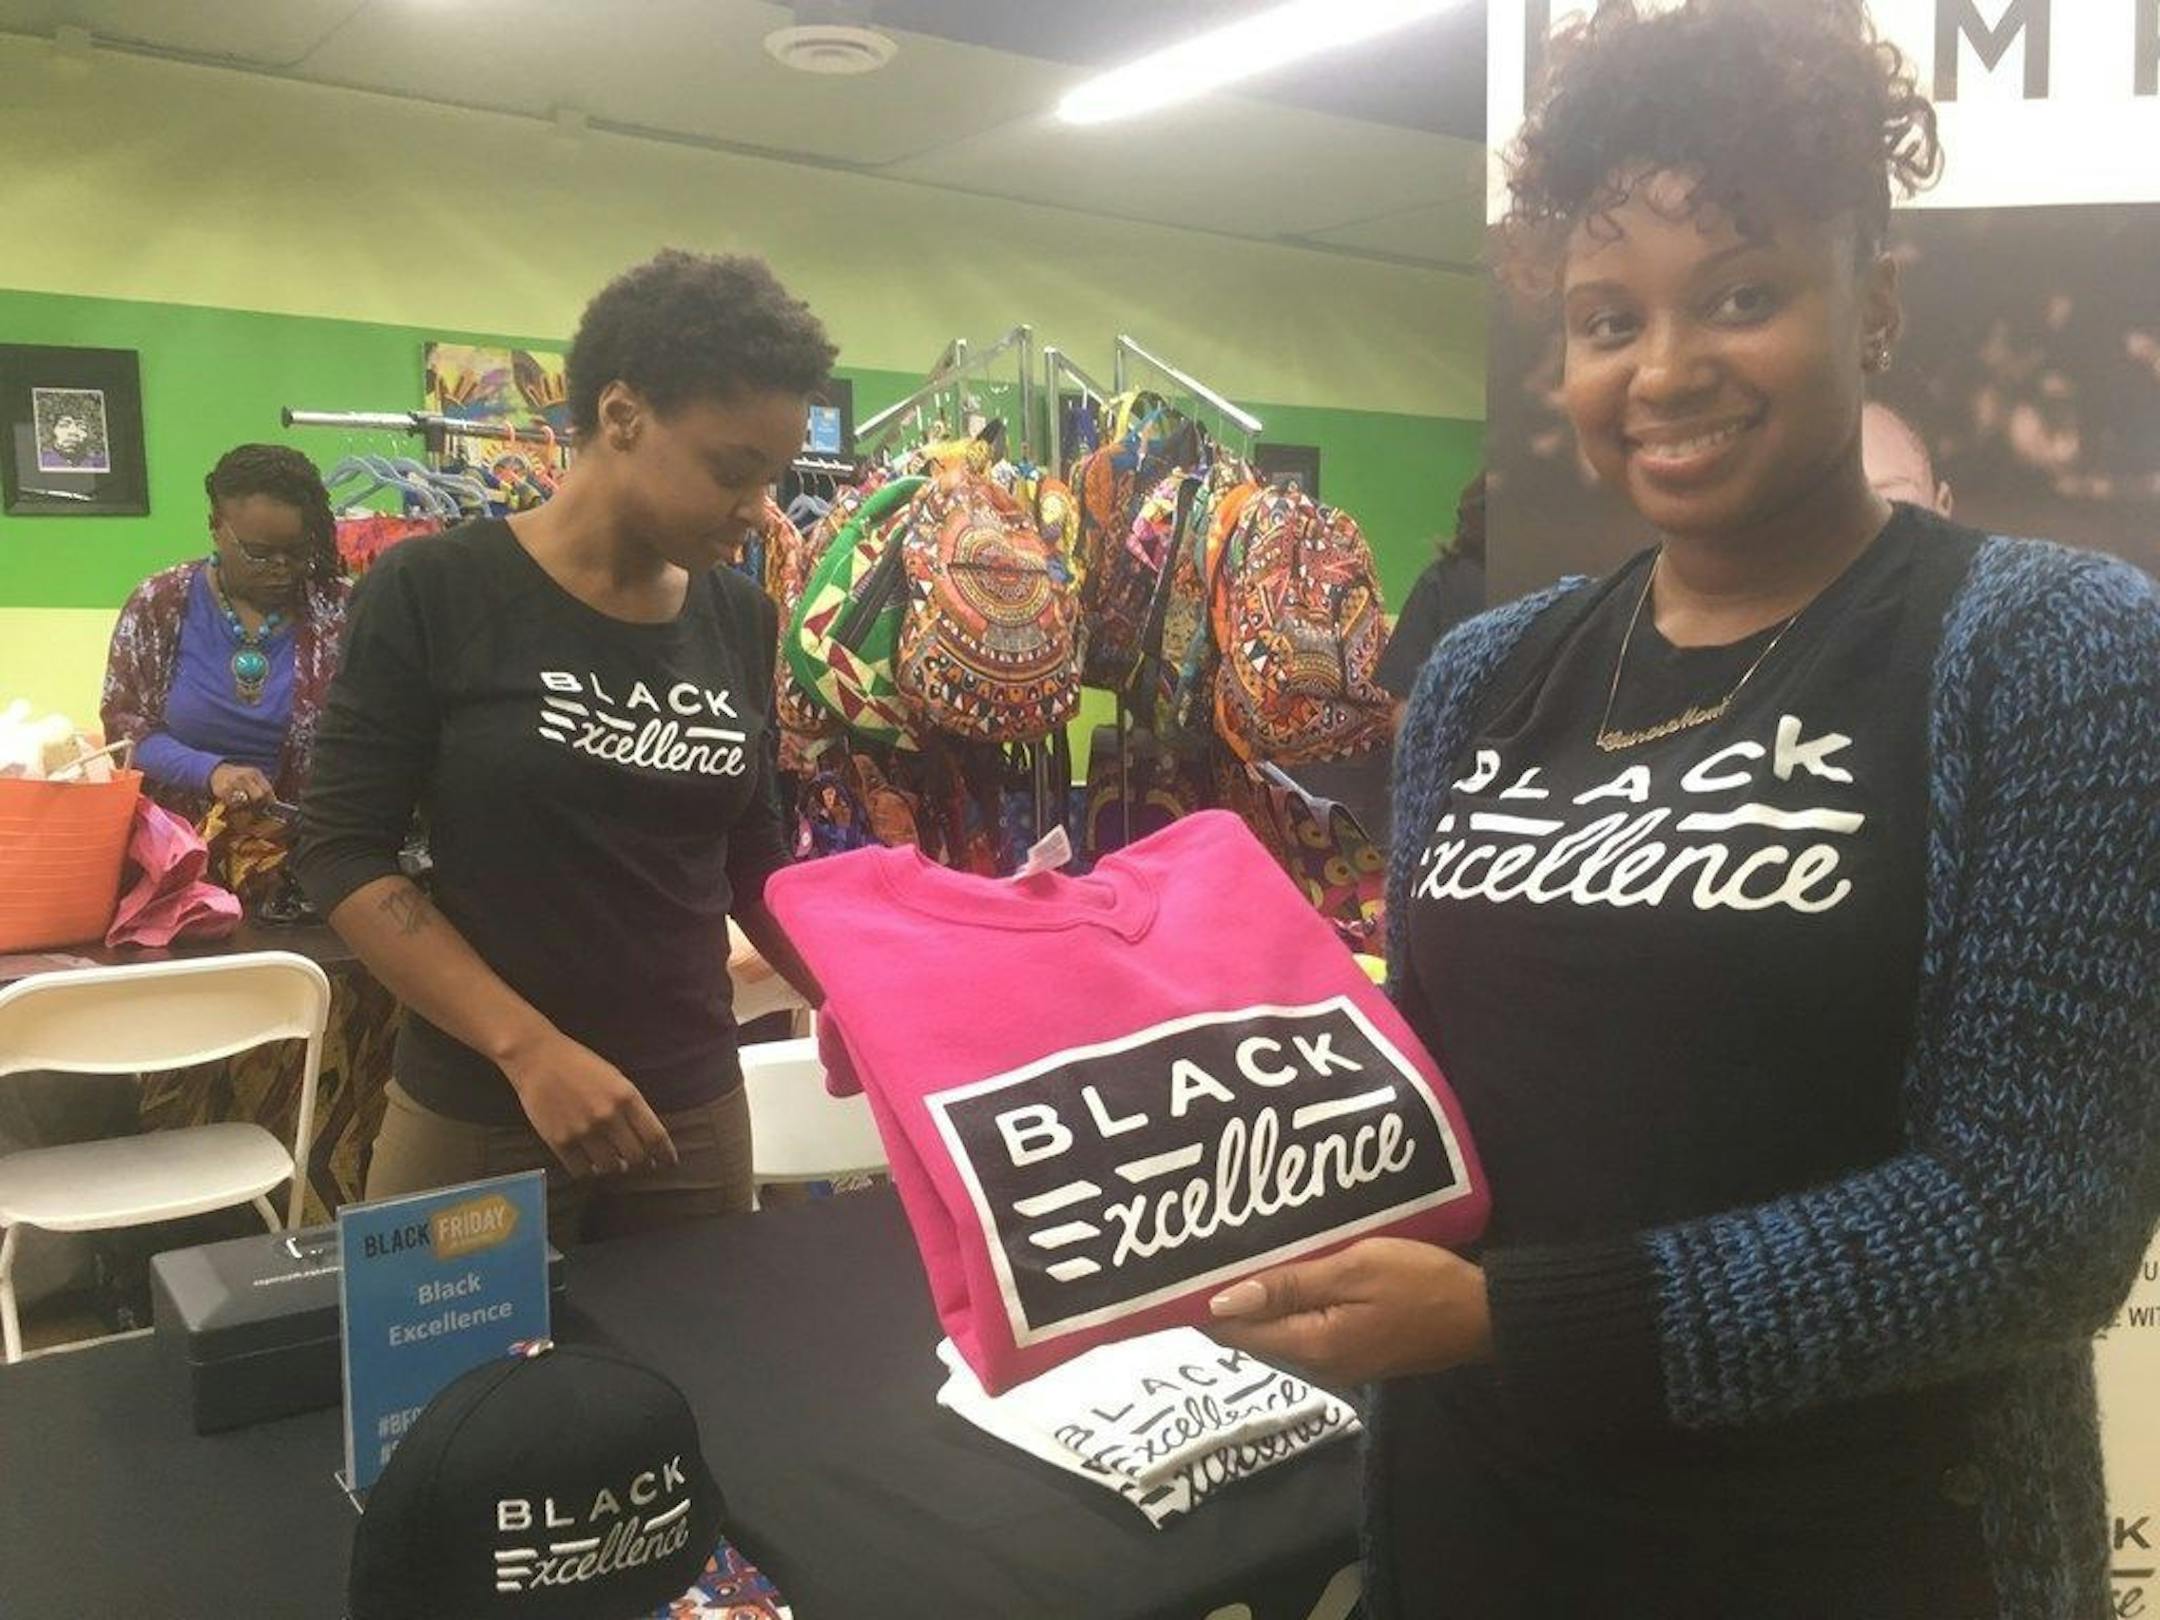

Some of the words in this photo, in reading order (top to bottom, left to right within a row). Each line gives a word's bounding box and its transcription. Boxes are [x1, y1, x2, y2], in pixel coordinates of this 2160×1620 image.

[540, 671, 738, 719] BLACK
[538, 696, 746, 776] Excellence
[995, 1032, 1363, 1168] BLACK
[364, 1223, 430, 1258] BLACK
[439, 1206, 505, 1241] FRIDAY
[1013, 1106, 1415, 1283] Excellence
[388, 1301, 514, 1347] Excellence
[418, 1271, 482, 1305] Black
[1055, 1350, 1250, 1450] BLACK
[497, 1456, 686, 1532] BLACK
